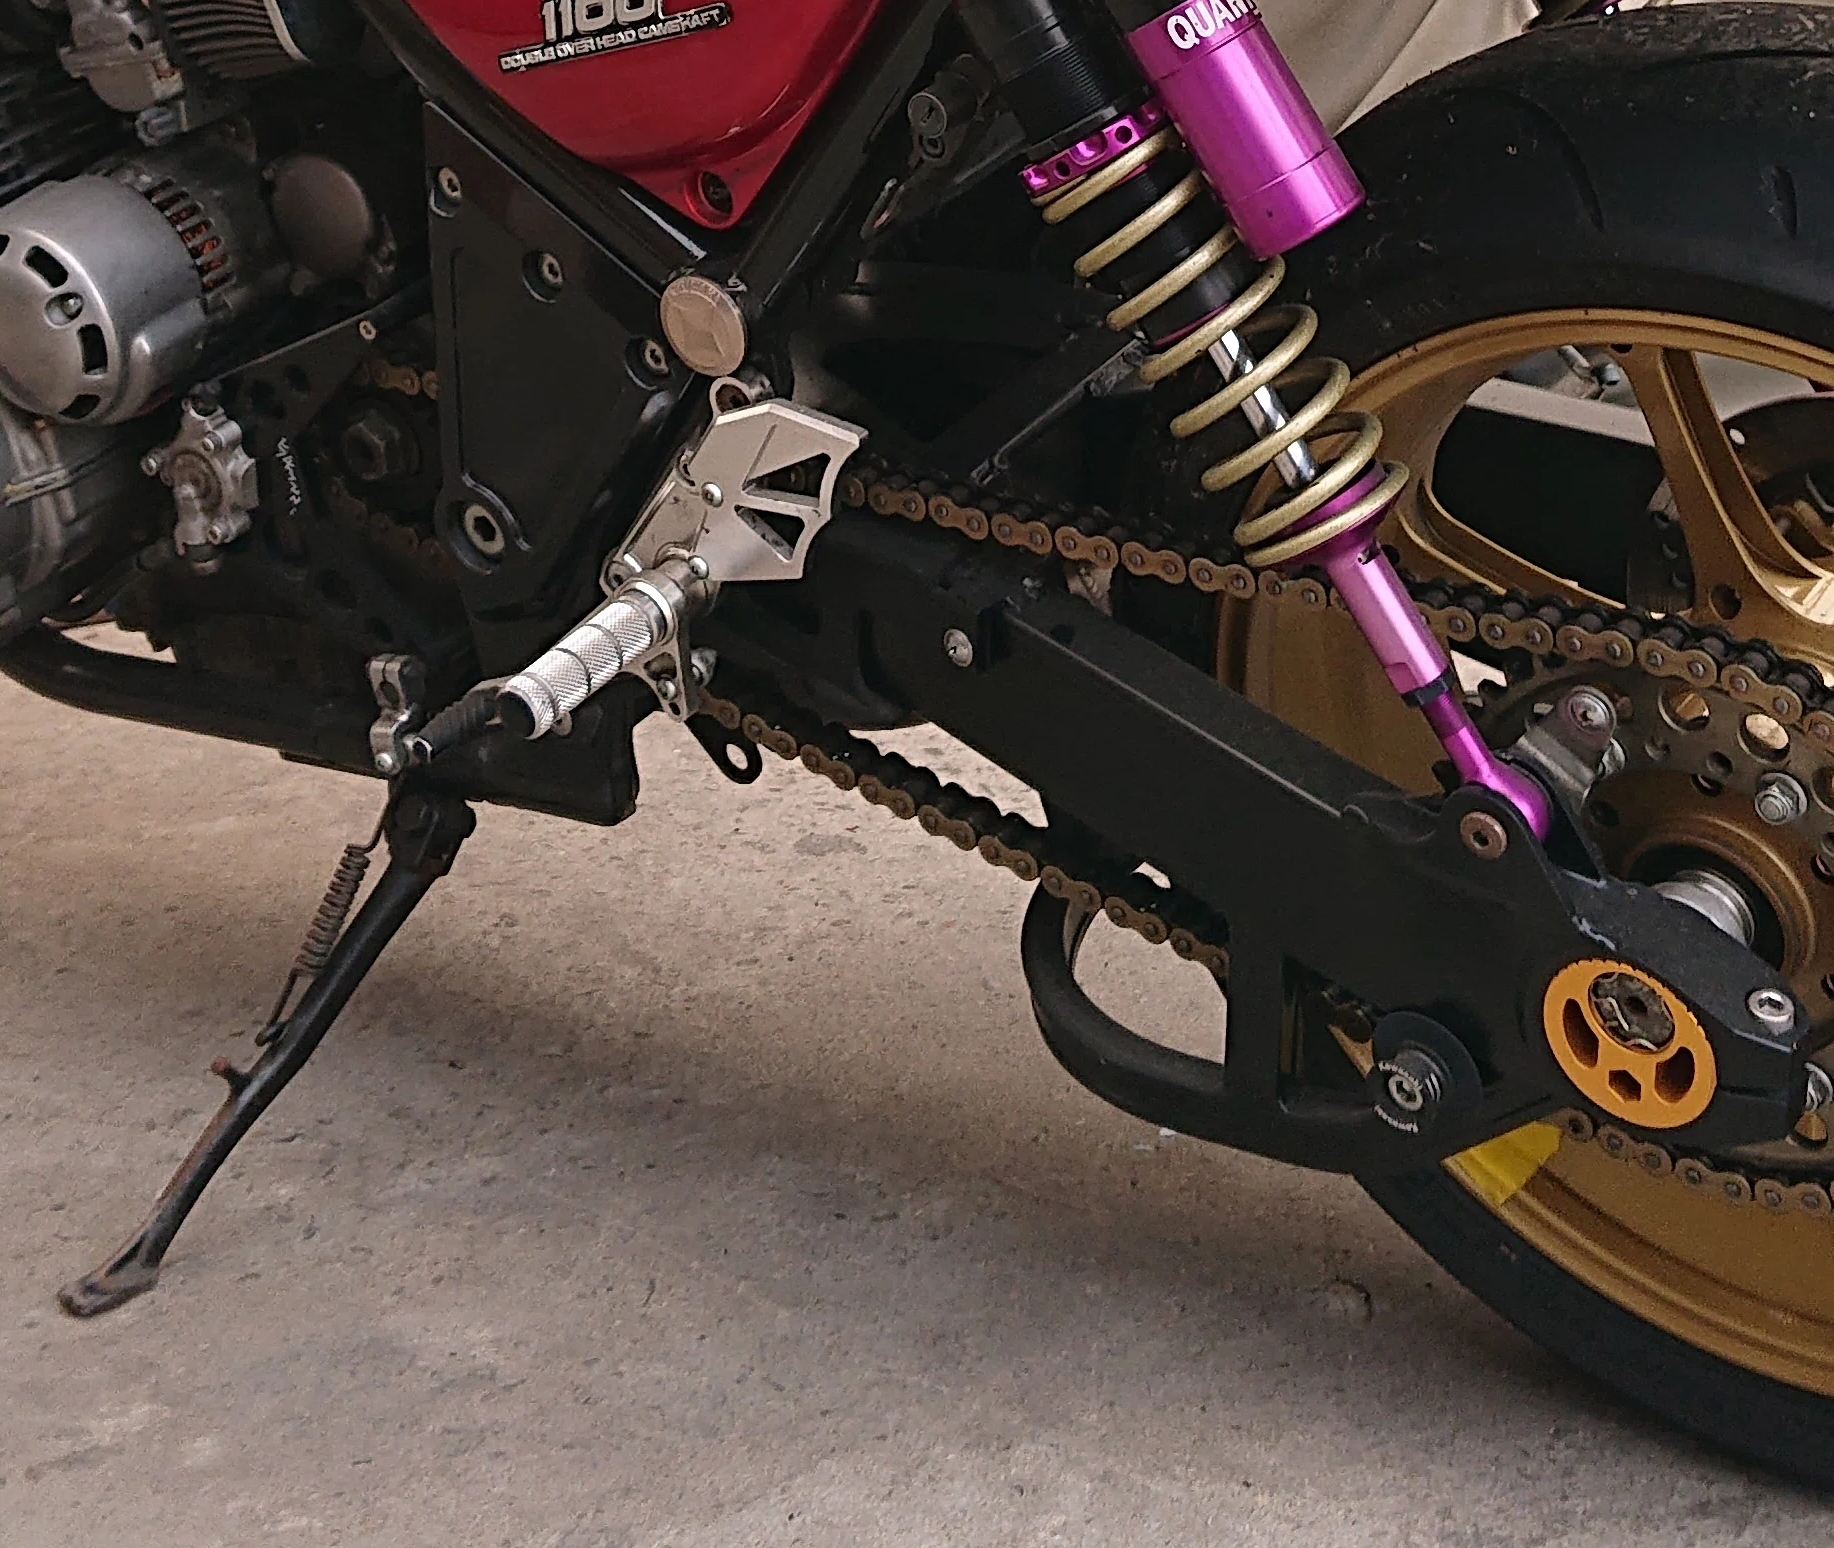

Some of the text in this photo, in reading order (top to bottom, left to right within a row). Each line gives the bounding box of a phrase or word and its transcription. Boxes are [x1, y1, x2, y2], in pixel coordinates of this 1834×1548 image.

[500, 8, 720, 70] DOUBLE OVER HEAD CAMSHAFT
